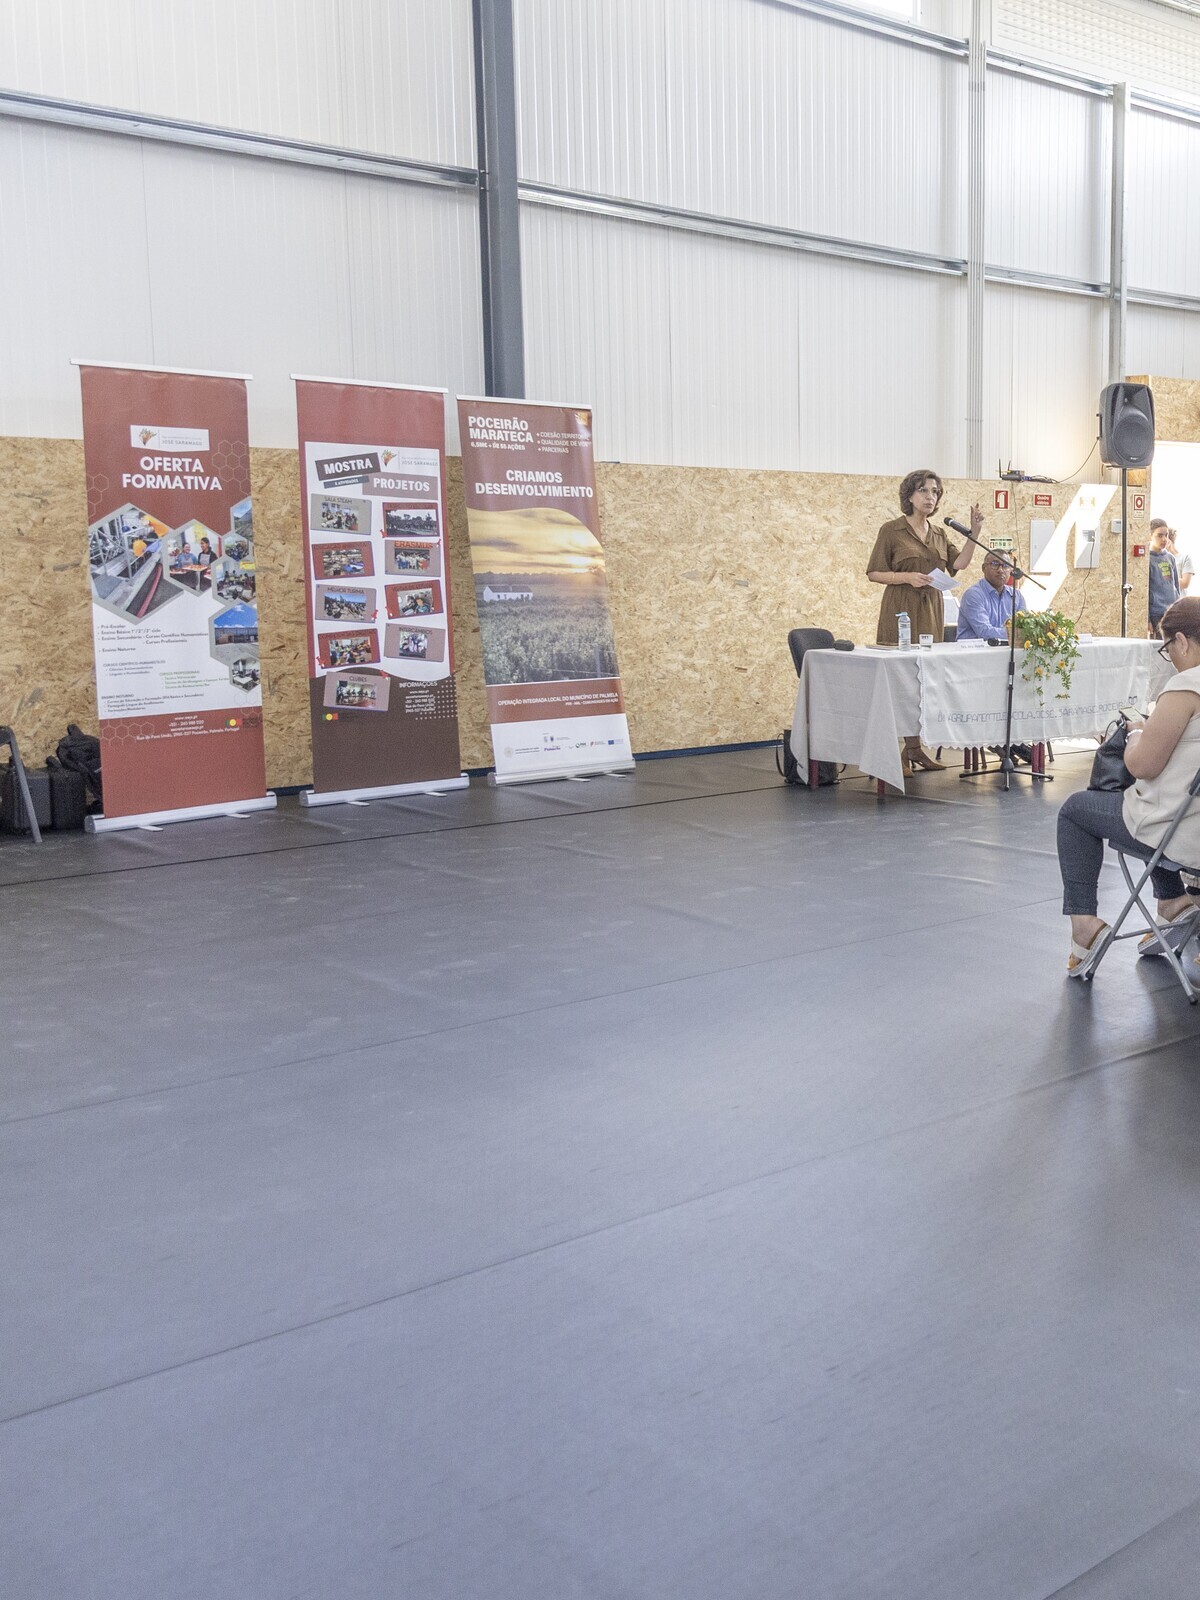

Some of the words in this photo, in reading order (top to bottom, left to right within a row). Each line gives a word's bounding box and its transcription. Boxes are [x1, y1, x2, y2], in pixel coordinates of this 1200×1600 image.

[468, 416, 528, 431] POCEIRÃO
[469, 428, 533, 443] MARATECA
[140, 456, 204, 472] OFERTA
[324, 458, 373, 474] MOSTRA
[122, 473, 222, 490] FORMATIVA
[373, 477, 430, 491] PROJETOS
[506, 470, 563, 483] CRIAMOS
[475, 482, 593, 498] DESENVOLVIMENTO
[399, 680, 438, 688] INFORMAÇÕES
